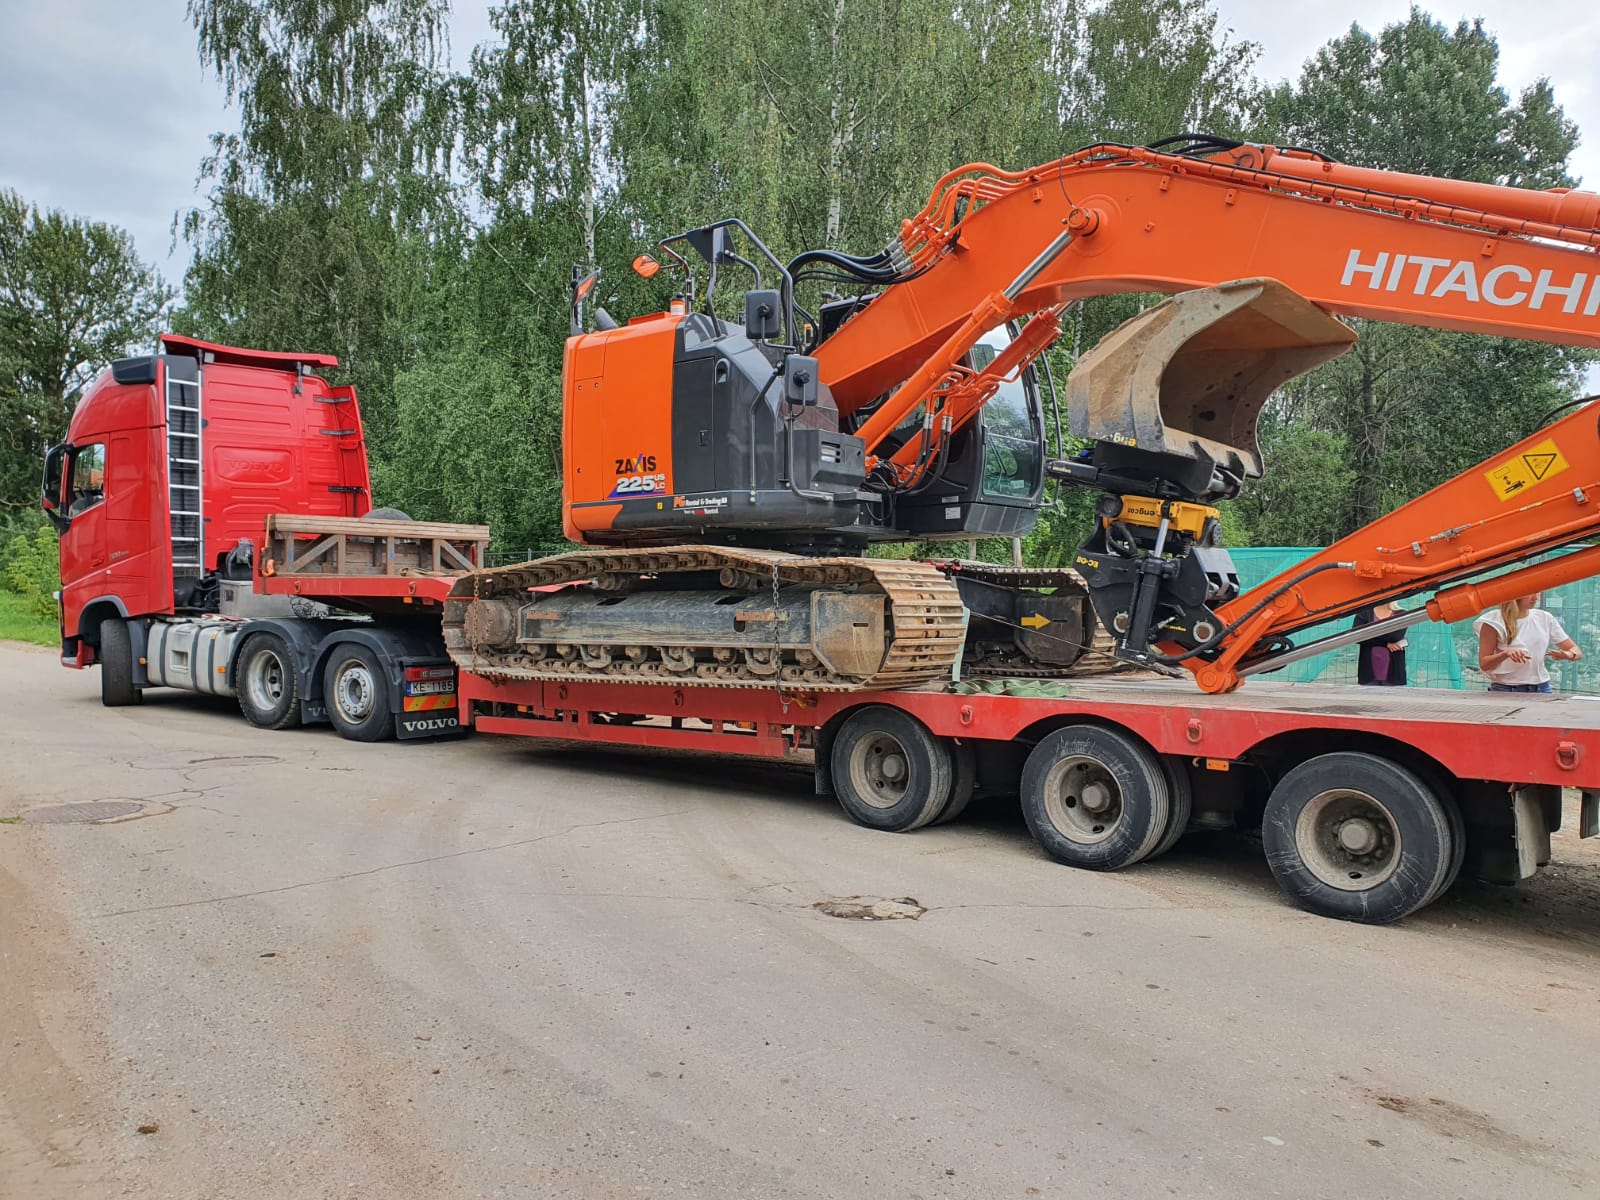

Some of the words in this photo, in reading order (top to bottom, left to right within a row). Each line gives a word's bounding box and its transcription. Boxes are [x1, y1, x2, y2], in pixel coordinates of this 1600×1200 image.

[1340, 248, 1600, 316] HITACHI
[615, 453, 657, 475] ZAXIS
[616, 475, 655, 493] 225
[654, 473, 666, 481] US
[655, 482, 666, 490] LC
[403, 717, 458, 732] VOLVO
